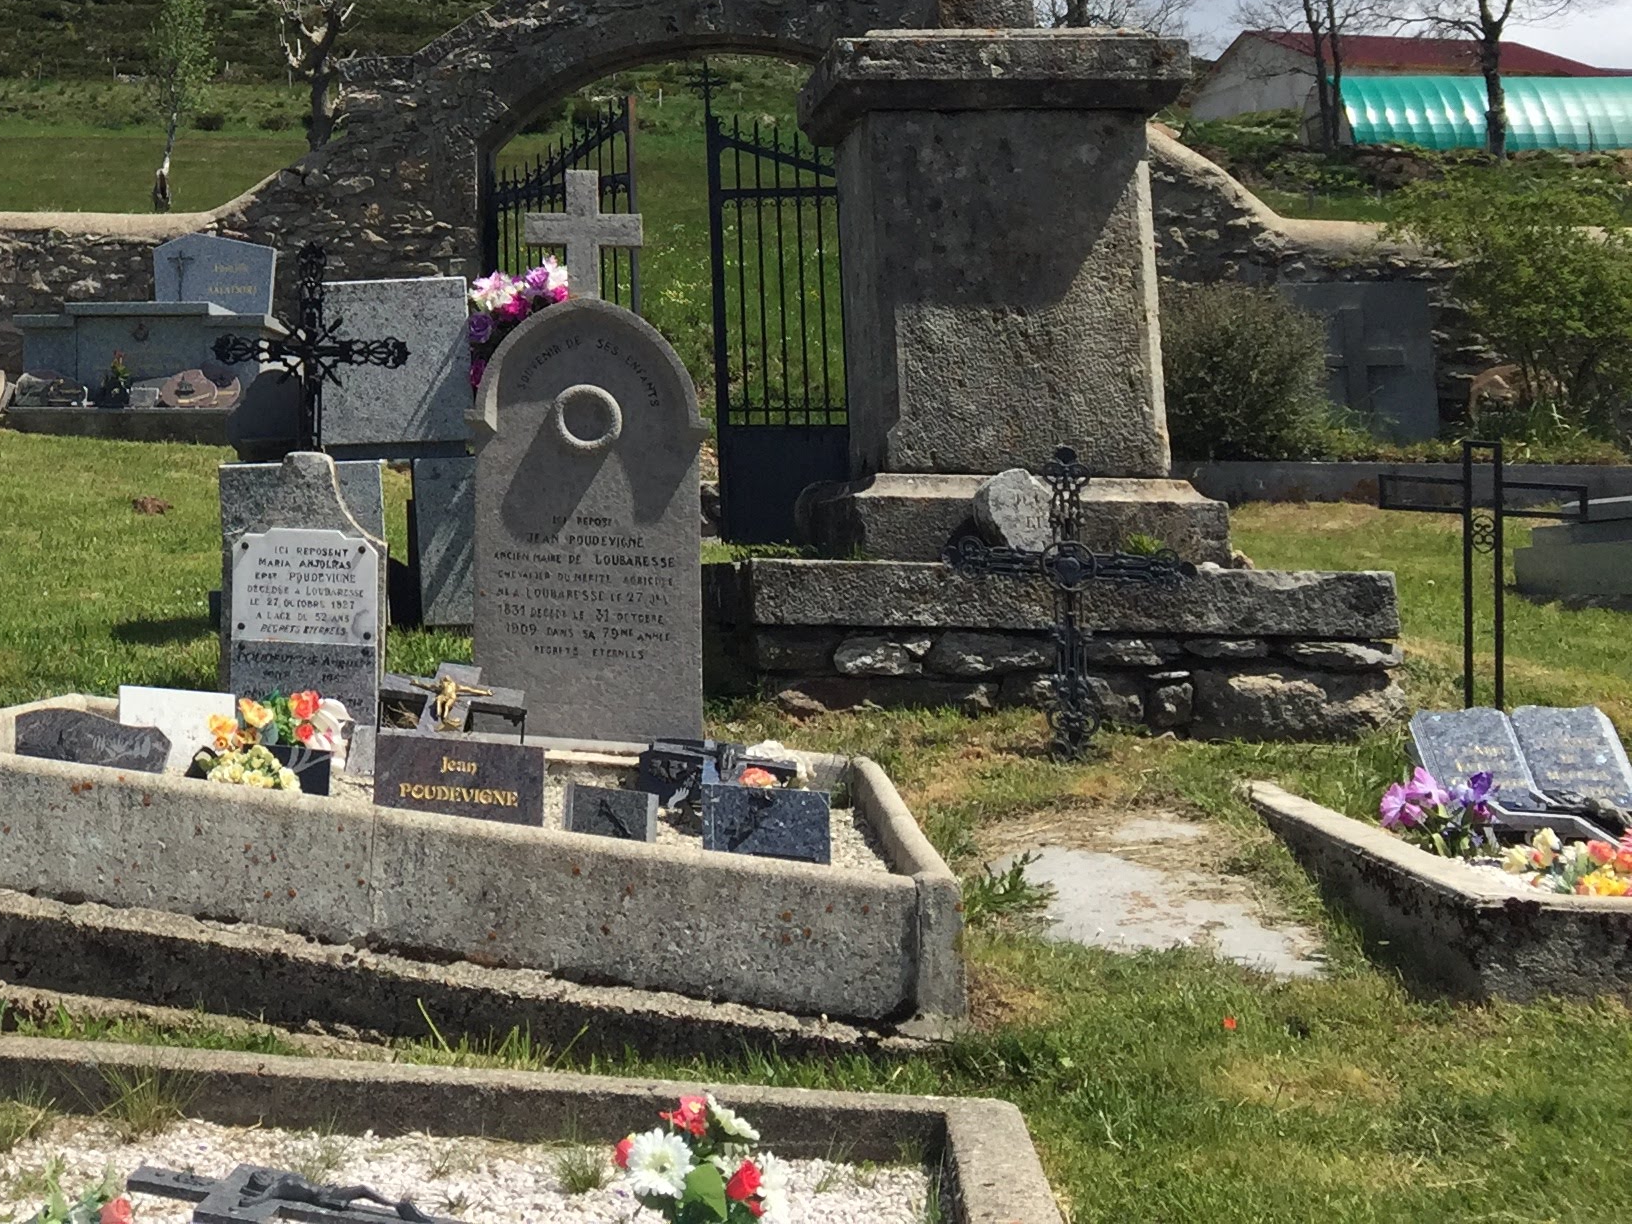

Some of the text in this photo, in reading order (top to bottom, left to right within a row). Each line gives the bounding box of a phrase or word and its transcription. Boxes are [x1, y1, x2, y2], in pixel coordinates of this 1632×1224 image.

[565, 335, 582, 350] DE
[596, 338, 618, 356] SES
[624, 355, 661, 408] ENFANTS
[526, 532, 645, 548] JEAN POUDEVIGNE
[296, 546, 349, 557] REPOSENT
[258, 557, 291, 568] MARIA
[533, 553, 562, 564] MAIRE
[568, 554, 582, 565] DE
[595, 554, 676, 568] LOUBARESSE
[288, 572, 356, 584] POUDEVIGNE
[267, 597, 279, 606] 27
[526, 588, 606, 602] LOUBARESSE
[626, 592, 644, 603] 27
[315, 612, 327, 622] 52
[573, 610, 585, 621] LE
[595, 608, 610, 622] 31
[506, 622, 538, 636] 1909
[582, 628, 596, 640] SA
[440, 756, 478, 775] Jean
[399, 782, 518, 807] POUDEVIGNE
